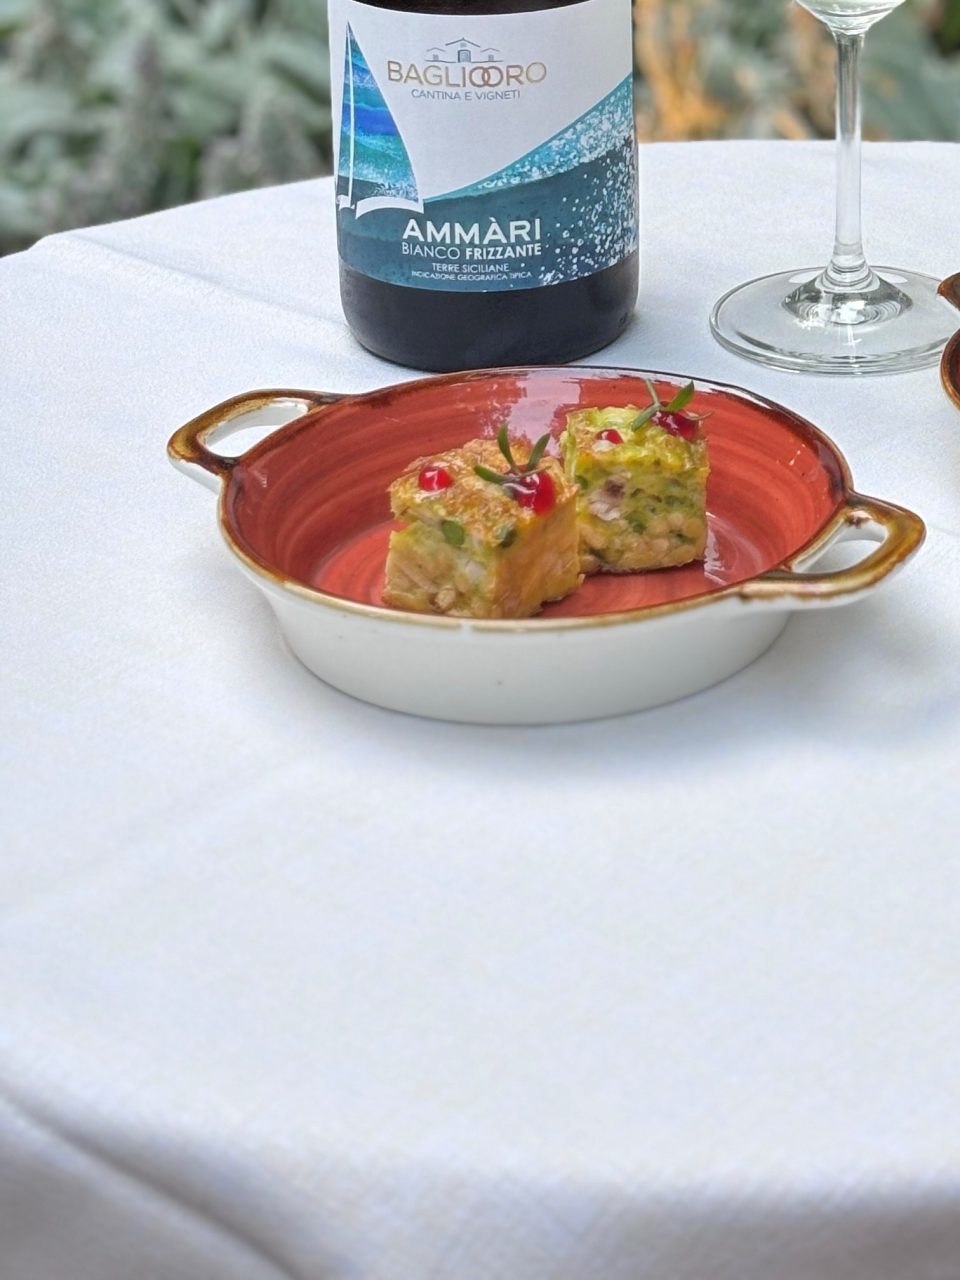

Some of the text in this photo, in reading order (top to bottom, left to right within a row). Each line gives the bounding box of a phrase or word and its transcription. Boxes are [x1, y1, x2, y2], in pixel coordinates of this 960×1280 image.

[411, 88, 521, 101] CANTINA E VIGNETI
[402, 217, 541, 245] AMMÀRI
[401, 242, 542, 260] BIANCO FRIZZANTE
[432, 262, 510, 274] TERRE SICILIANE
